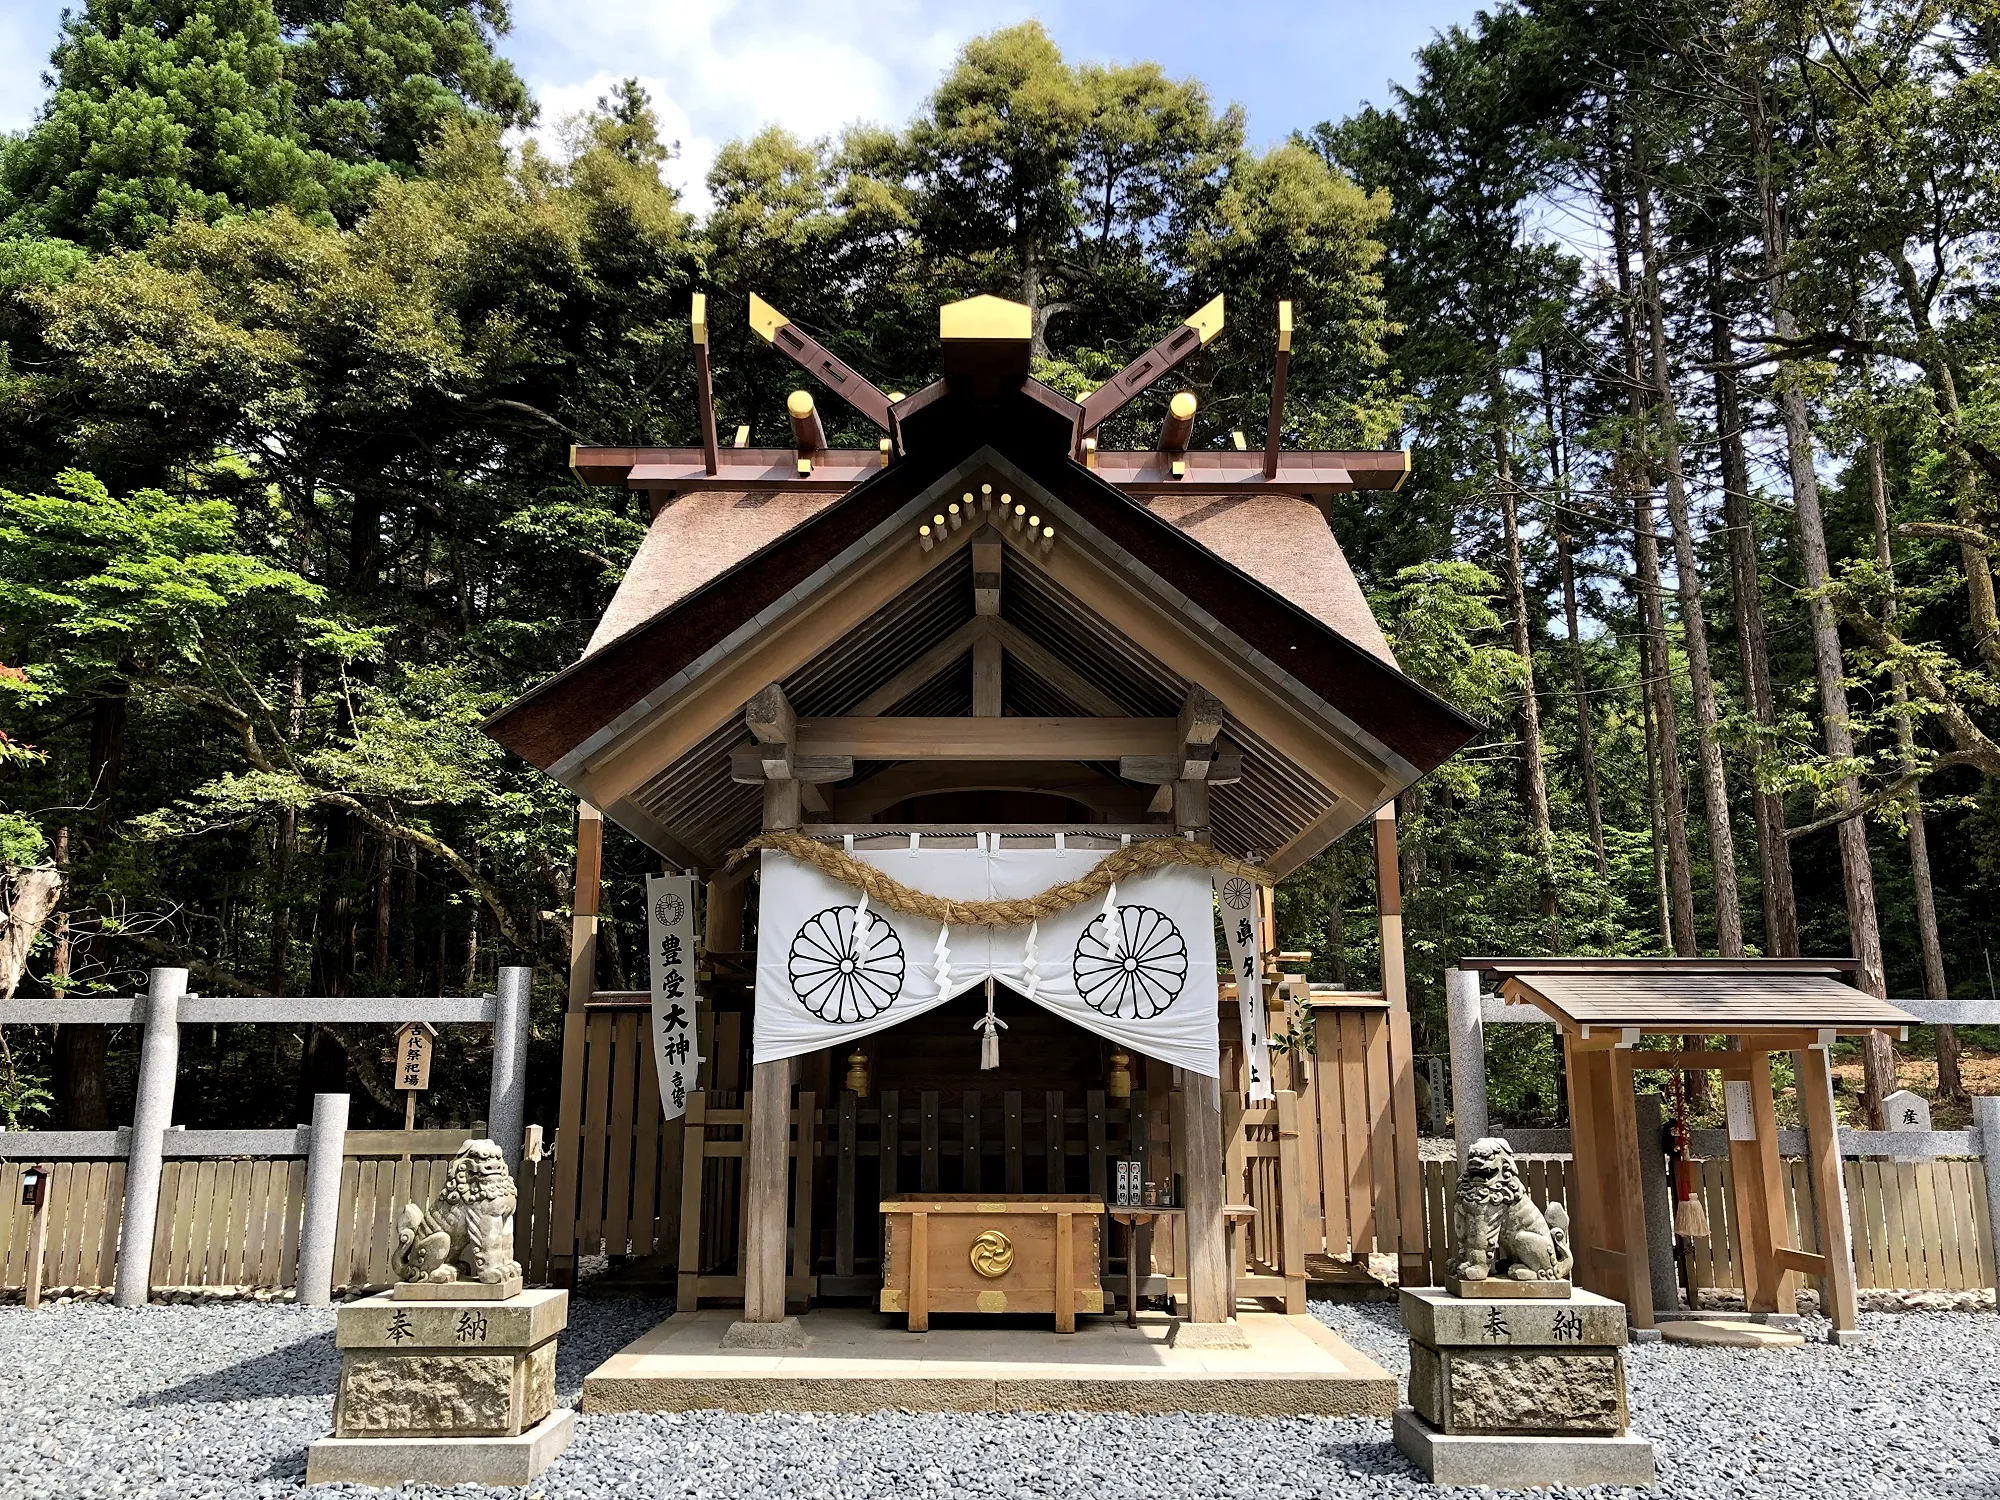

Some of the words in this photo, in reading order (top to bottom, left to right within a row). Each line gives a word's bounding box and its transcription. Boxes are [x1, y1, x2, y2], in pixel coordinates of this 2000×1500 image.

[660, 933, 690, 1066] 豊受大神
[403, 1024, 424, 1086] 古代祭祀場
[1902, 1108, 1919, 1124] 産
[386, 1309, 488, 1345] 奉納
[1482, 1306, 1583, 1343] 奉納
